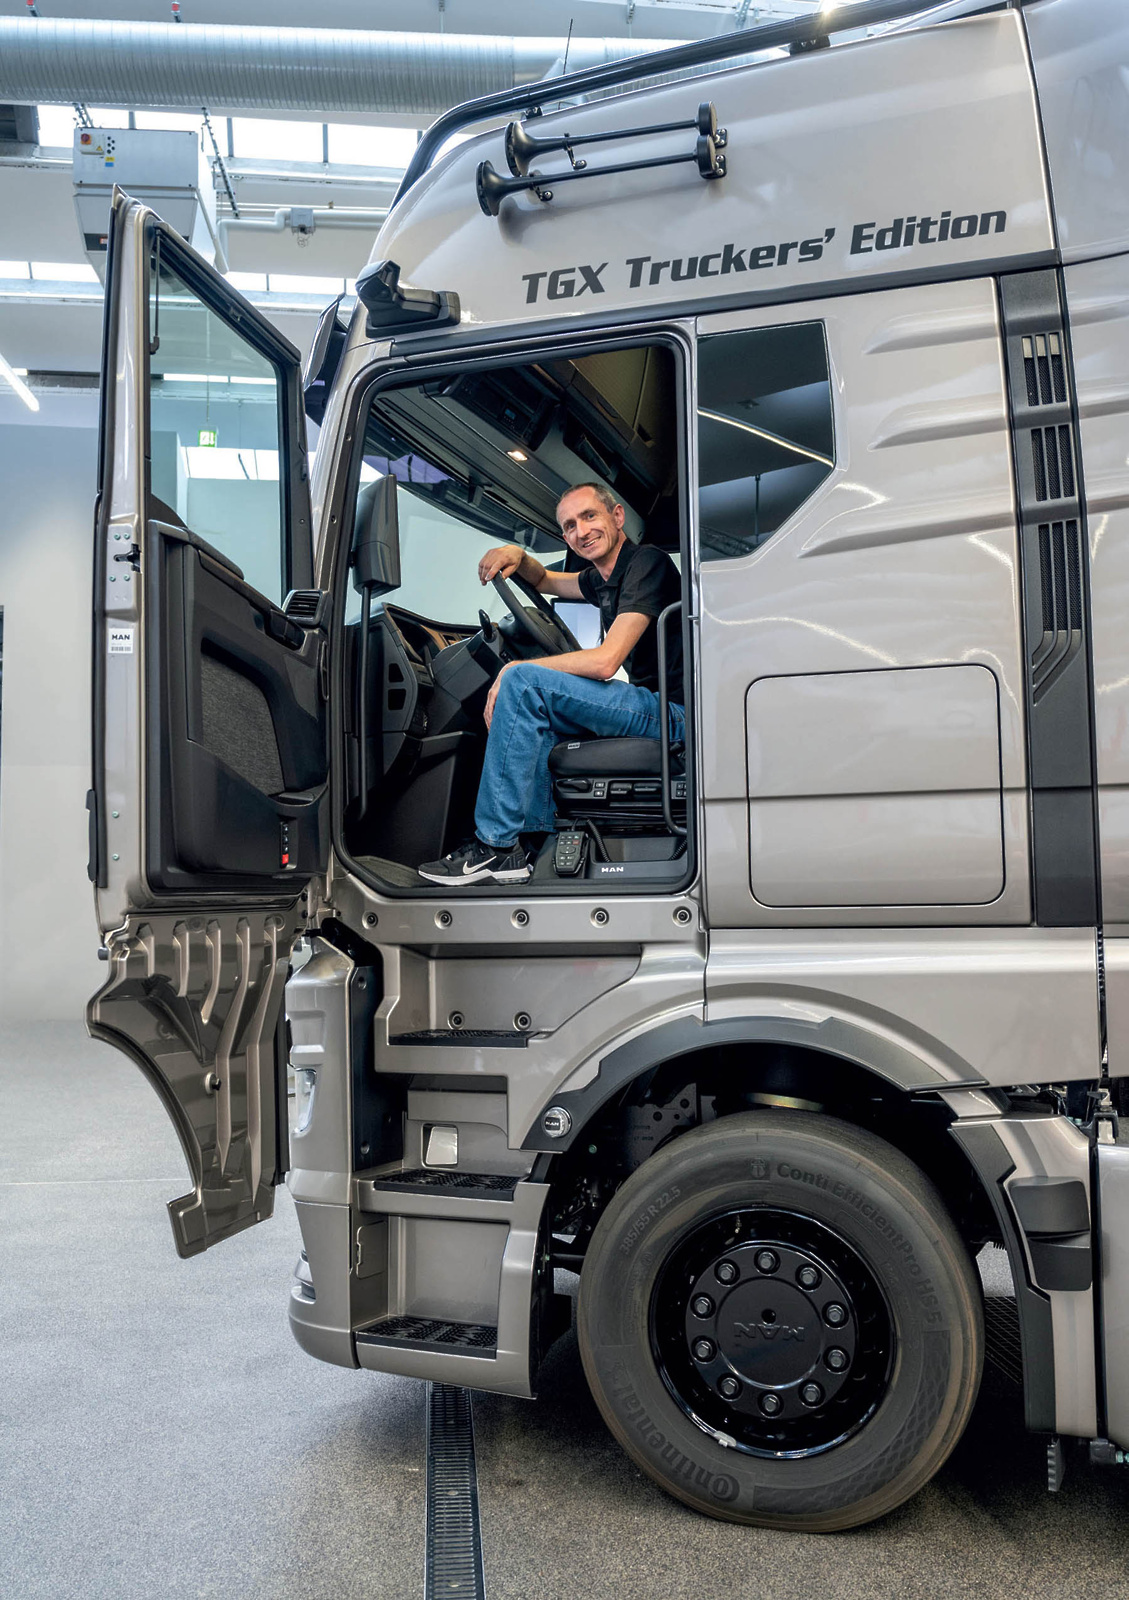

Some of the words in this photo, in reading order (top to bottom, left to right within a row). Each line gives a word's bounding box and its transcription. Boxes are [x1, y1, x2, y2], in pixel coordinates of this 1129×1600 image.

[521, 262, 609, 304] TGX
[850, 210, 1008, 256] Edition
[647, 1205, 659, 1219] R
[655, 1186, 682, 1210] 22.5
[776, 1163, 829, 1192] Conti
[832, 1182, 921, 1276] EfficientPro
[733, 1322, 806, 1342] MAN
[612, 1384, 741, 1503] Continental
